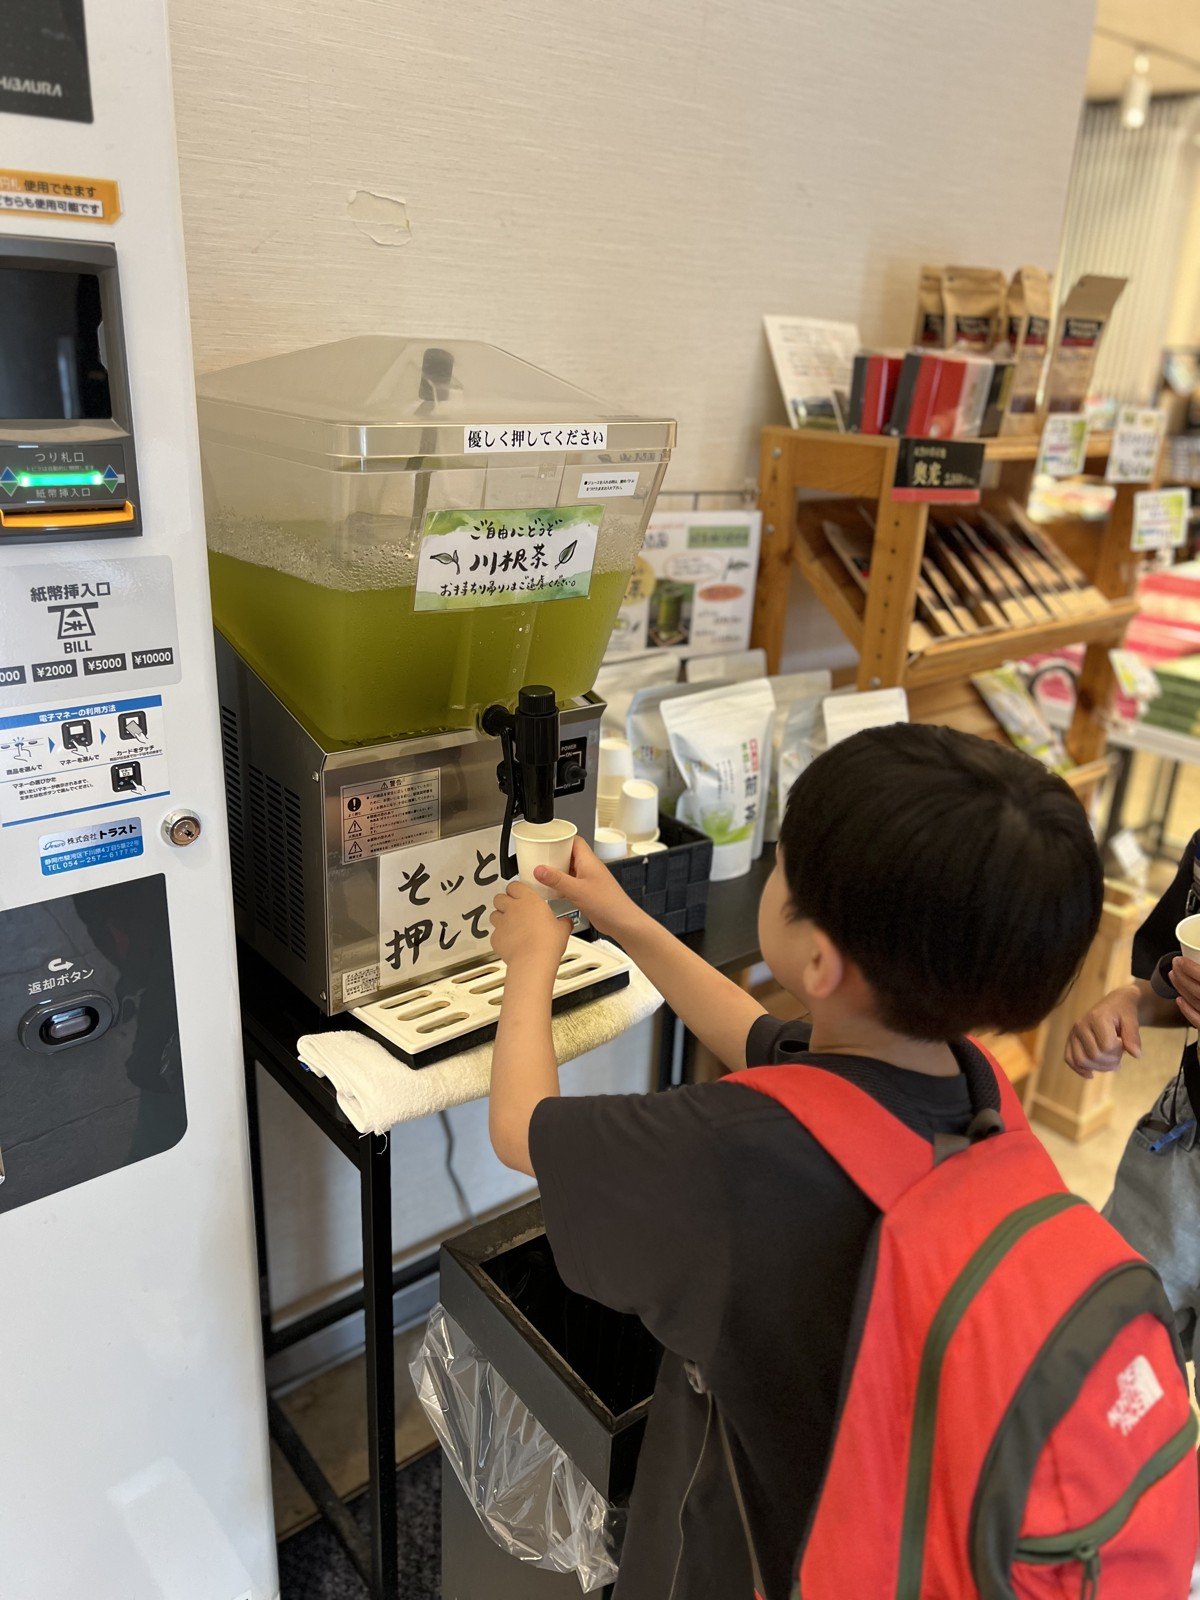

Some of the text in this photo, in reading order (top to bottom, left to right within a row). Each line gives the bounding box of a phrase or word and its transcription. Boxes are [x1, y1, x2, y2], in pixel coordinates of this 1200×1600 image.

[24, 180, 97, 198] 使用できます
[0, 195, 100, 214] ちらも使用可能です
[468, 429, 604, 448] 優しく押してください
[35, 452, 84, 463] つり札口
[36, 487, 91, 499] 紙幣挿入口
[470, 518, 563, 540] ご自由にどうぞ
[469, 543, 549, 575] 川根茶
[30, 582, 111, 603] 紙幣挿入口
[440, 575, 576, 596] お持ち帰りはご遠慮ください。
[63, 640, 93, 654] BILL
[36, 663, 73, 677] ¥2000
[87, 657, 122, 671] ¥5000
[134, 651, 171, 665] ¥10000
[39, 705, 116, 722] 電子マネーの利用方法
[117, 745, 154, 756] カードをタッチ
[60, 754, 99, 766] マネーを選んで
[6, 764, 42, 776] 商品を選んで
[12, 777, 56, 789] マネーの選びかた
[389, 779, 402, 787] 警告
[67, 833, 97, 845] 株式会社
[99, 824, 137, 840] トラスト
[48, 864, 61, 872] TEL
[385, 904, 490, 970] 押して
[28, 968, 94, 995] 返却ボタン
